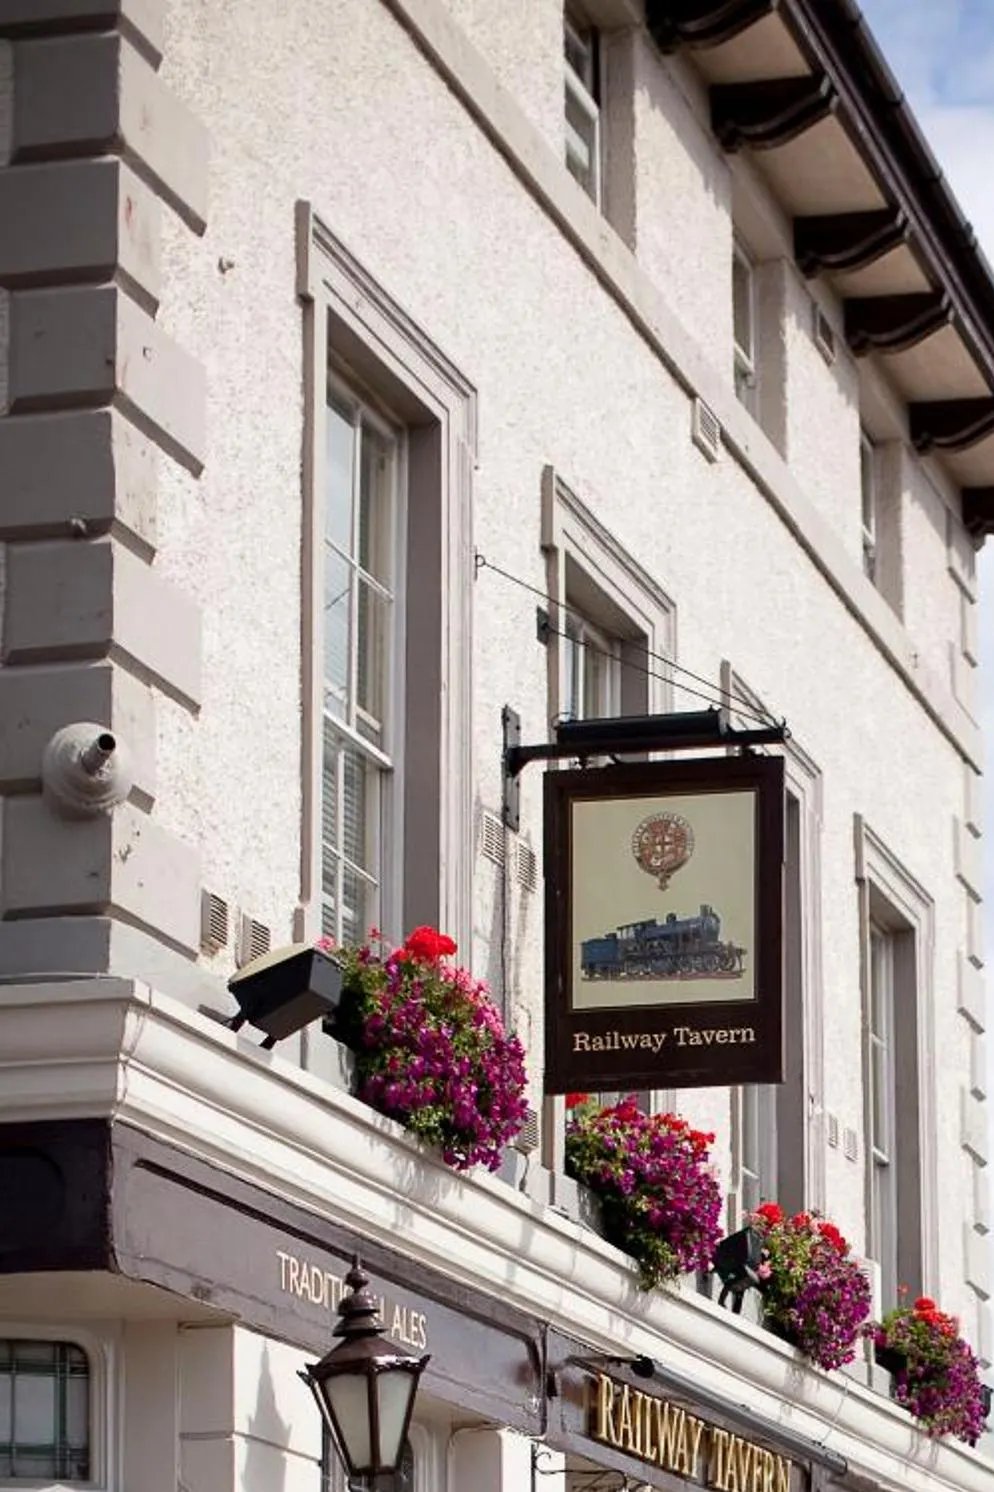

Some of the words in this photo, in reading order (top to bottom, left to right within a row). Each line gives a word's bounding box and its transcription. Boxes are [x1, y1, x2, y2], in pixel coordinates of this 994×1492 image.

[572, 1031, 667, 1053] Railway
[673, 1027, 755, 1046] Tavern
[276, 1250, 389, 1333] TRADITIL
[391, 1303, 427, 1350] ALES
[599, 1373, 705, 1480] RAILWAY
